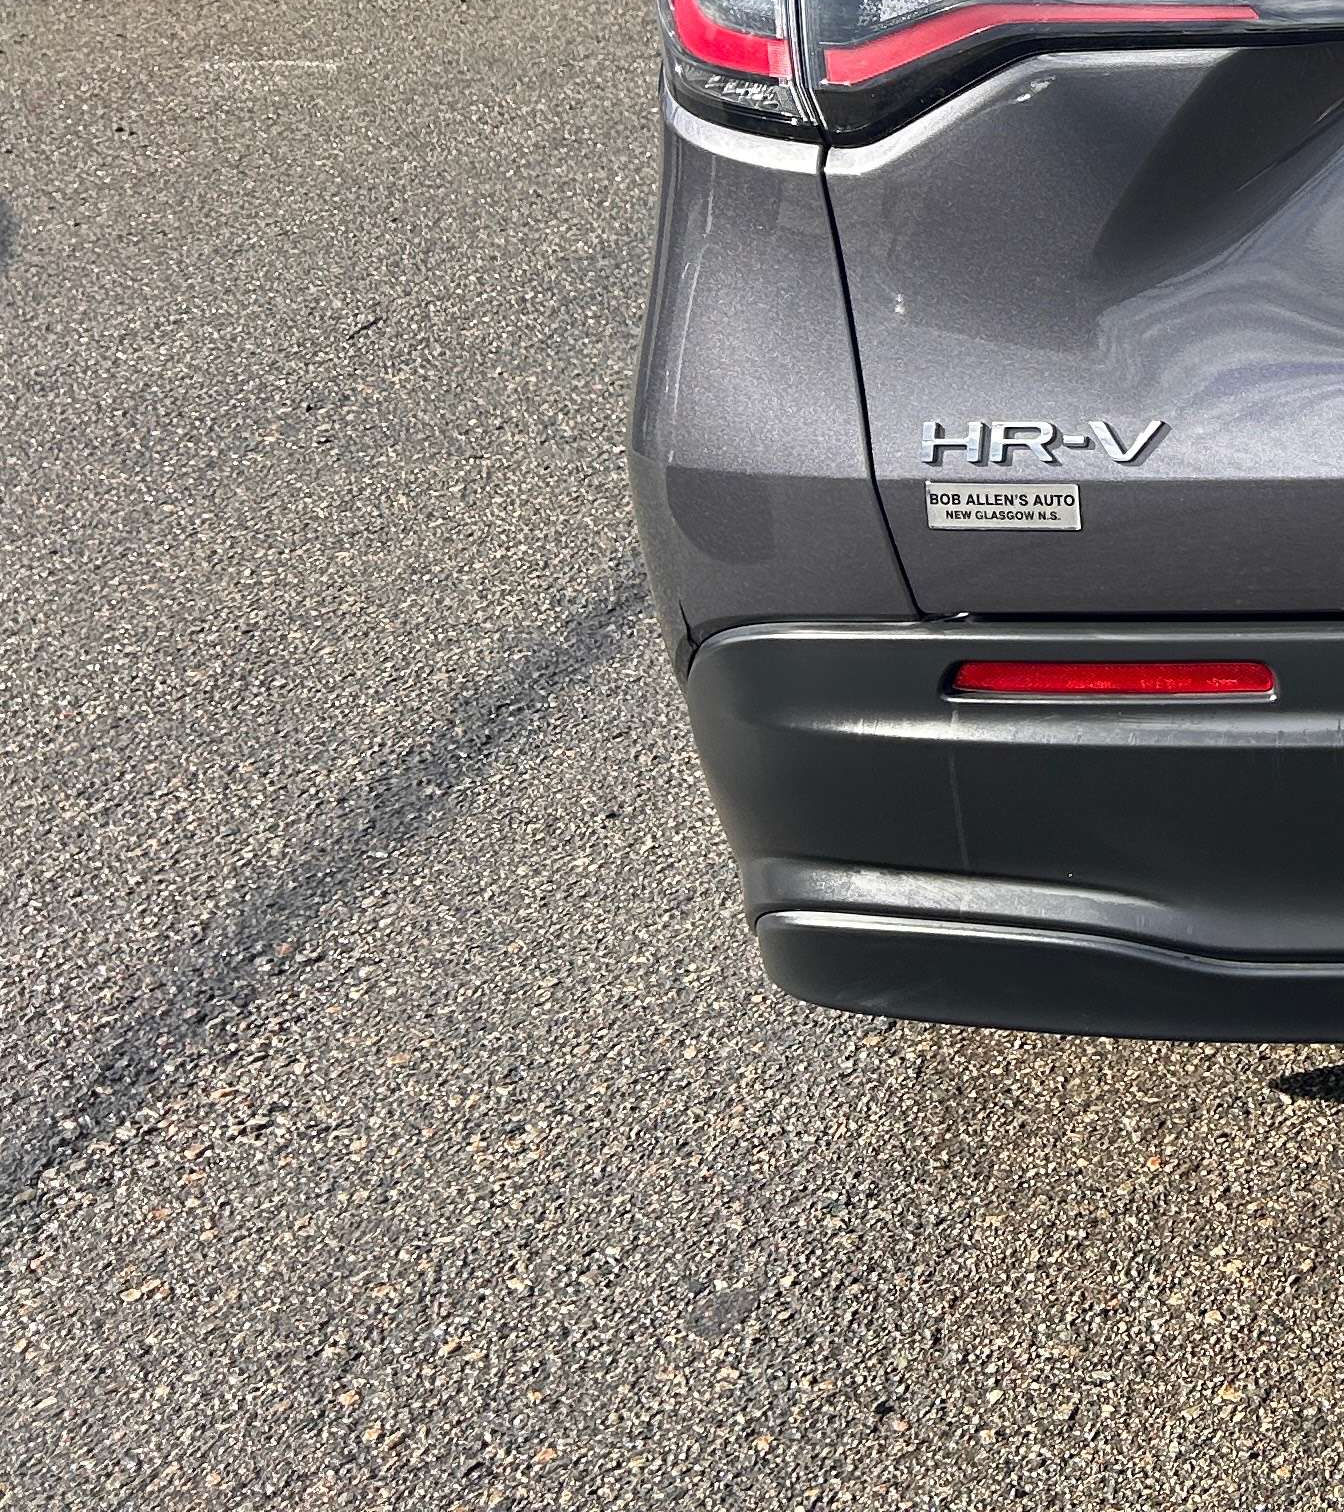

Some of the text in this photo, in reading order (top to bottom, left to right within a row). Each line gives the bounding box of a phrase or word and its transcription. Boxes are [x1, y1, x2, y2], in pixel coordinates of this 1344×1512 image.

[921, 420, 1171, 465] HR-V
[929, 493, 1075, 506] BOB ALLEN'S AUTO
[945, 509, 1061, 521] NEW GLASGOW N.S.
